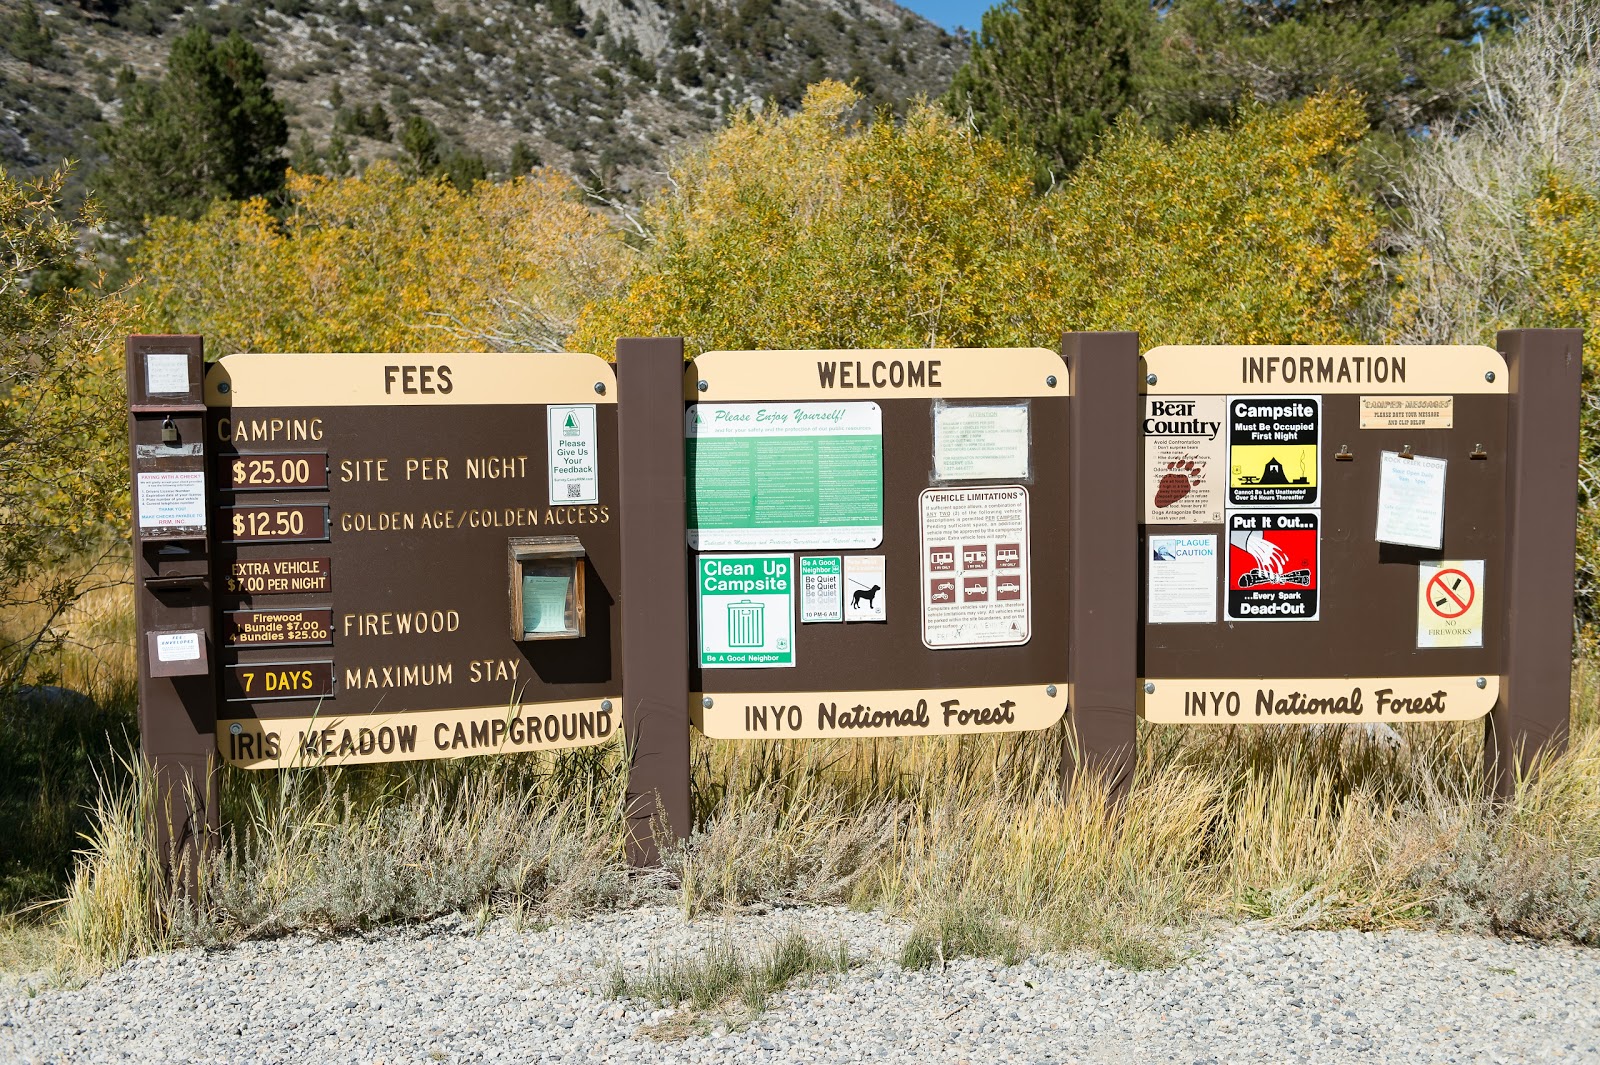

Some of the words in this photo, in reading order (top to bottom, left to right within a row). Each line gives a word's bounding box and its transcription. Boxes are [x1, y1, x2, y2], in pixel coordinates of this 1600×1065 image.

[817, 361, 942, 388] WELCOME
[1243, 357, 1406, 383] INFORMATION
[384, 365, 453, 394] FEES
[714, 410, 750, 422] Please
[756, 409, 788, 423] Enjoy
[793, 409, 846, 424] Yourself!
[1151, 401, 1195, 416] Bear
[1235, 403, 1313, 420] Campsite
[218, 417, 323, 442] CAMPING
[1143, 419, 1221, 440] Country
[1273, 423, 1314, 431] Occupied
[1274, 432, 1297, 441] Night
[232, 460, 309, 484] $25.00
[340, 459, 389, 482] SITE
[406, 457, 449, 481] PER
[466, 456, 528, 479] NIGHT
[1423, 461, 1443, 470] LODGE
[967, 492, 1018, 500] LIMITATIONS
[232, 510, 303, 536] $12.50
[341, 512, 414, 532] GOLDEN
[421, 509, 538, 529] AGE/GOLDEN
[544, 505, 609, 526] ACCESS
[1234, 517, 1256, 528] Put
[1262, 517, 1271, 528] It
[1277, 516, 1313, 528] Out...
[232, 563, 270, 576] EXTRA
[274, 561, 319, 574] VEHICLE
[704, 561, 754, 576] Clean
[763, 561, 786, 577] Up
[227, 578, 264, 592] $7.00
[268, 579, 288, 590] PER
[292, 578, 326, 590] NIGHT
[704, 577, 787, 593] Campsite
[1245, 592, 1275, 600] ...Every
[1279, 592, 1301, 600] Spark
[1241, 603, 1305, 614] Dead-Out
[253, 613, 302, 622] Firewood
[344, 610, 460, 637] FIREWOOD
[244, 622, 282, 632] Bundle
[286, 621, 319, 631] $7.00
[240, 632, 284, 641] Bundles
[287, 630, 327, 640] $25.00
[242, 674, 254, 691] 7
[265, 670, 313, 691] DAYS
[346, 664, 453, 690] MAXIMUM
[469, 658, 520, 683] STAY
[1184, 691, 1240, 716] INYO
[1256, 687, 1363, 716] National
[1375, 689, 1447, 715] Forest
[745, 705, 802, 731] INYO
[818, 699, 929, 730] National
[941, 699, 1016, 727] Forest
[230, 732, 282, 760] IRIS
[298, 725, 417, 758] MEADOW
[434, 710, 611, 750] CAMPGROUND
